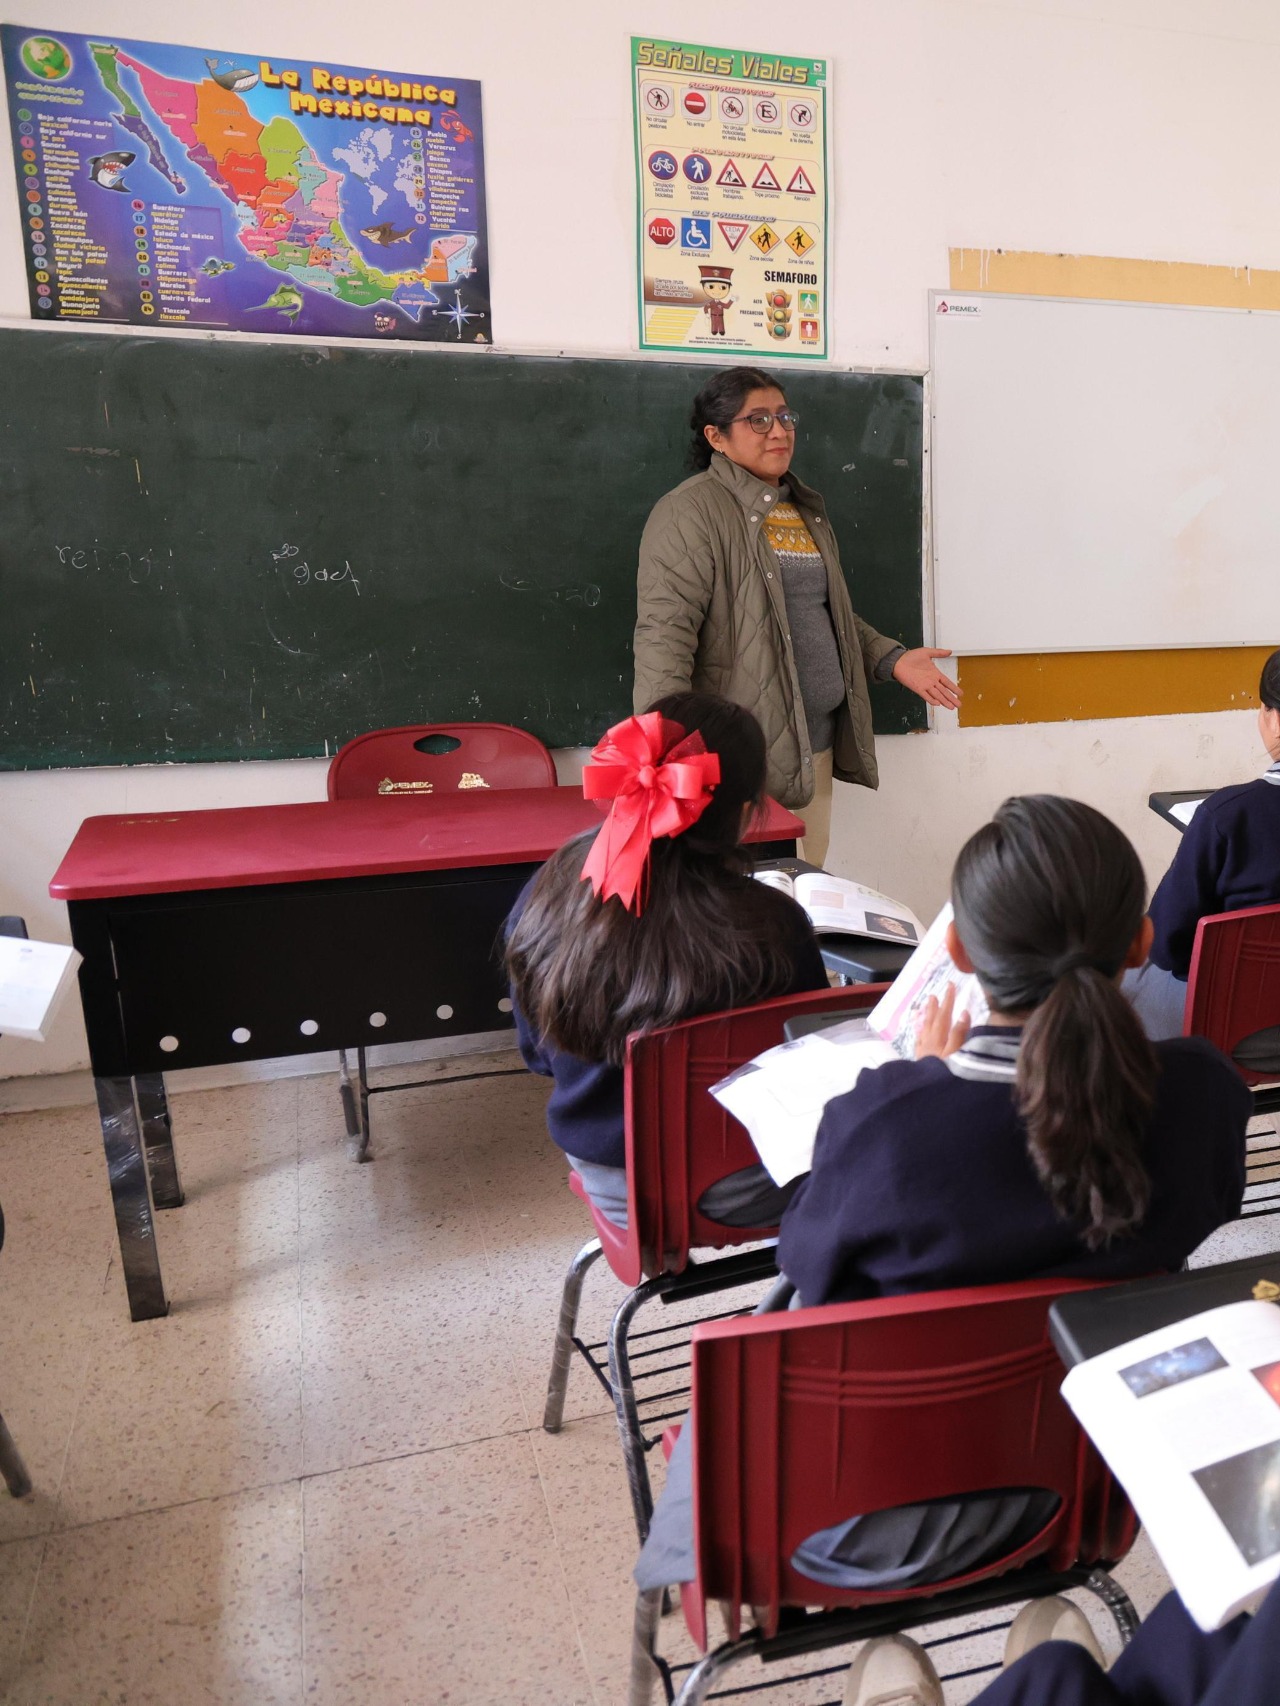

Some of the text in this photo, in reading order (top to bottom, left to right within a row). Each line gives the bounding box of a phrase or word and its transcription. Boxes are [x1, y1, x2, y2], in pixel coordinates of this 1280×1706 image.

[637, 42, 809, 84] Señales Viales
[260, 61, 456, 105] La República
[290, 91, 431, 126] Mexicana
[650, 227, 674, 237] ALTO
[765, 271, 817, 285] SEMAFORO
